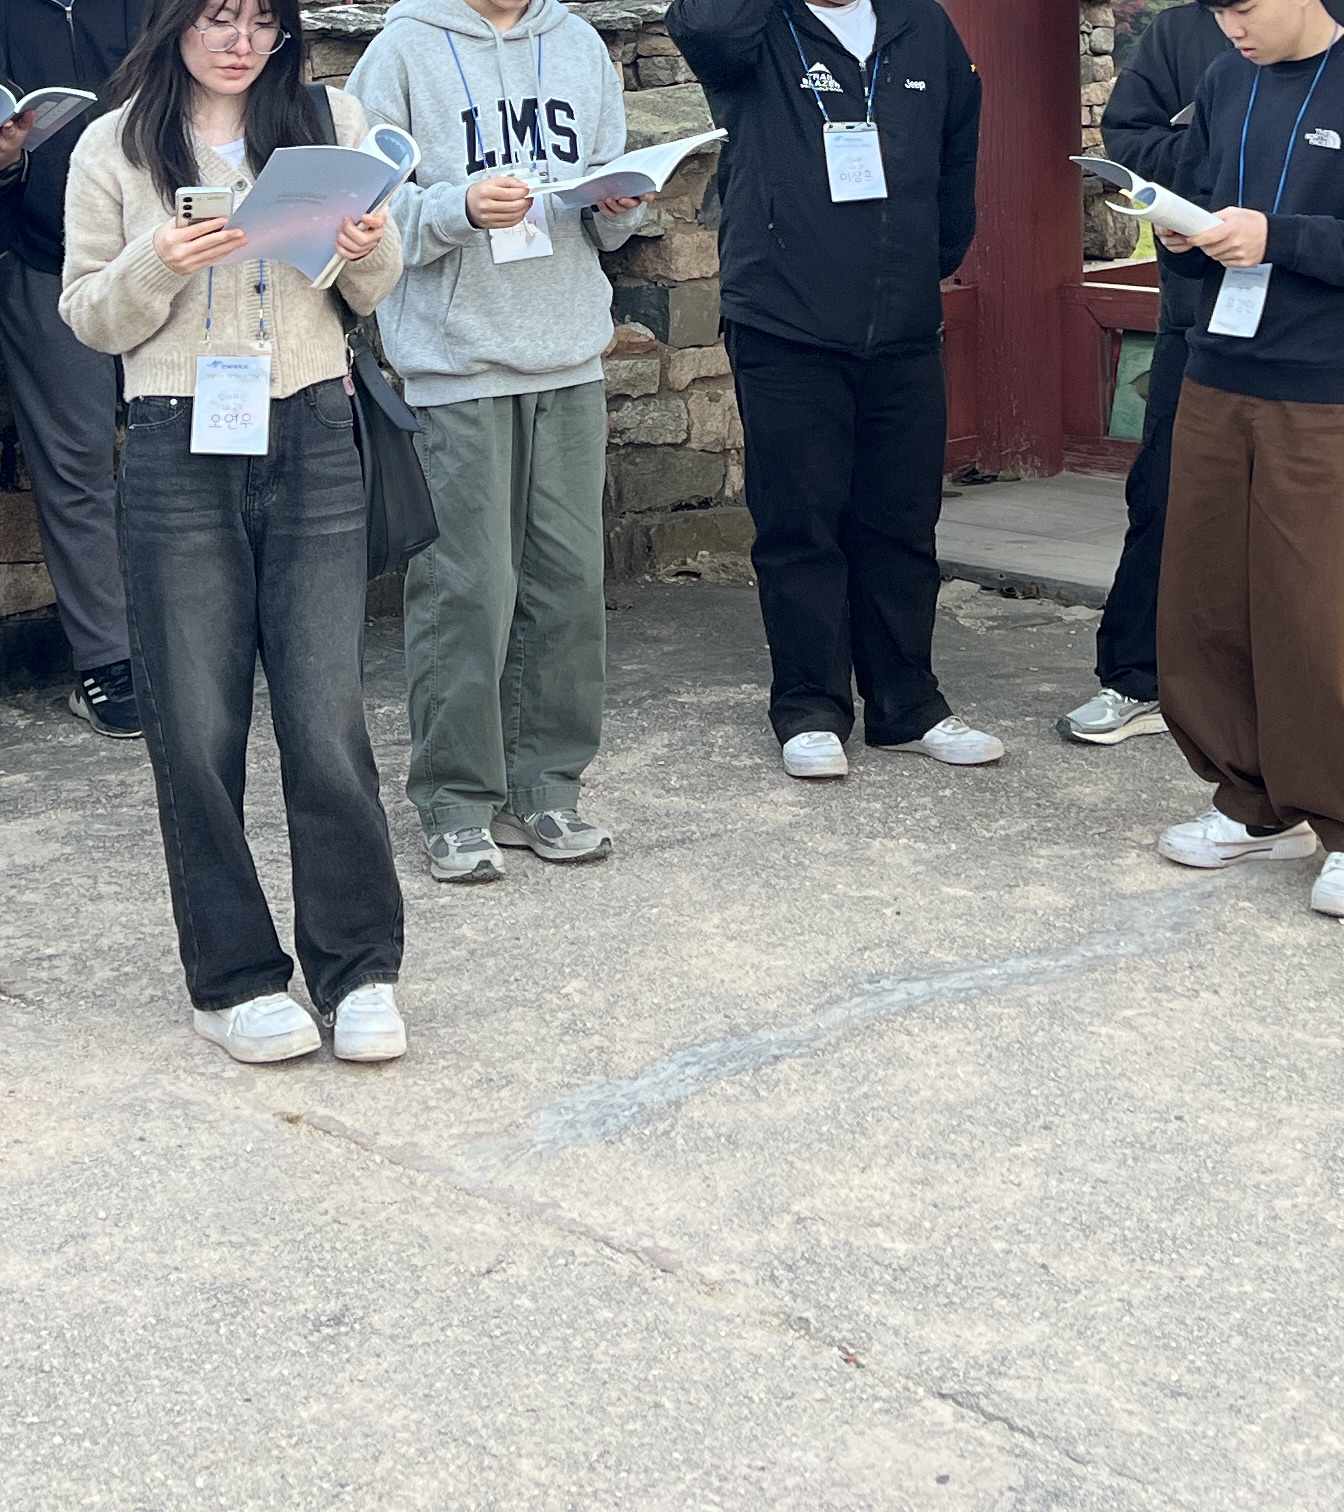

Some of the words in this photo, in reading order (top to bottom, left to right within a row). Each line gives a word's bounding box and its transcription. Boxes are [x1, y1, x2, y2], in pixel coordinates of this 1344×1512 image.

[904, 78, 926, 91] Jeep
[460, 96, 582, 178] LMS
[208, 412, 253, 430] 오연우
